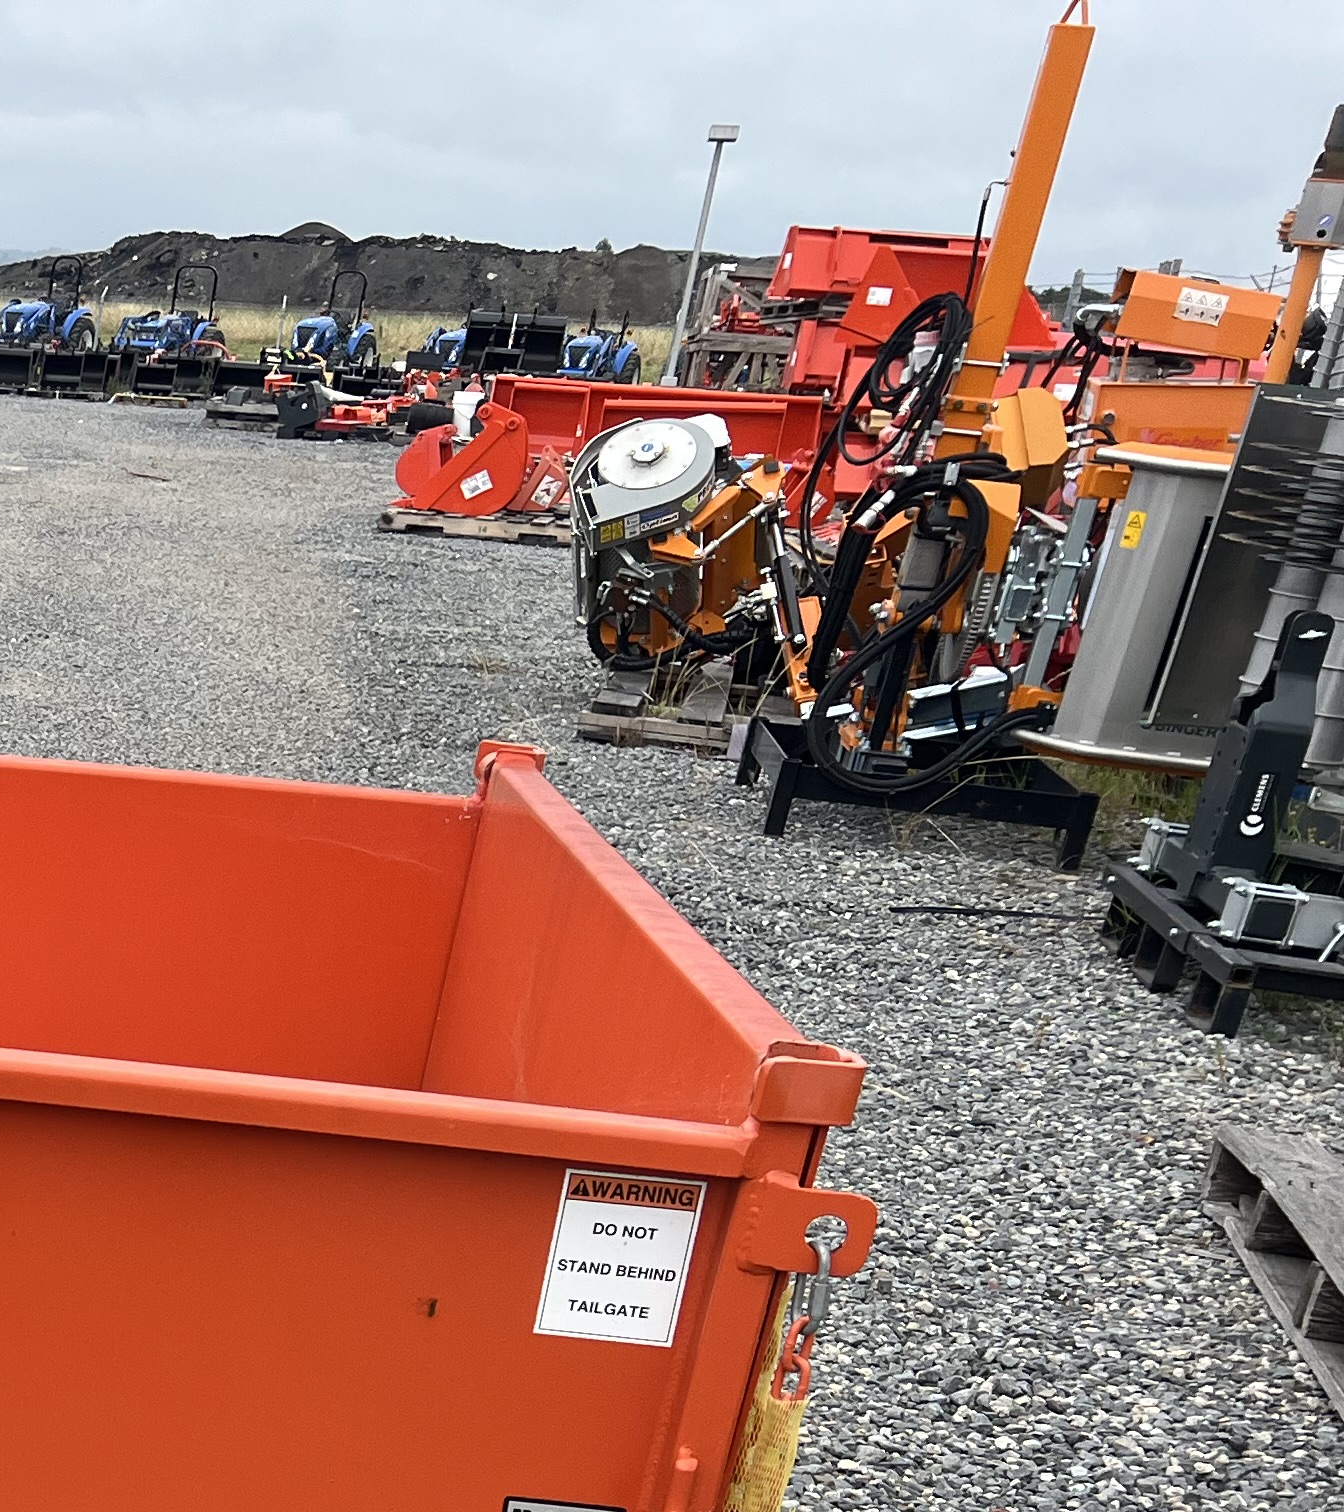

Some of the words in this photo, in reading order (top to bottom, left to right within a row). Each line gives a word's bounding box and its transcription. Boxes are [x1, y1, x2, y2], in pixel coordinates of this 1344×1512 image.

[1251, 773, 1270, 812] CLEMENS
[592, 1180, 695, 1207] WARNING
[592, 1222, 617, 1236] DO
[622, 1225, 659, 1240] NOT
[557, 1258, 612, 1276] STAND
[615, 1265, 676, 1282] BEHIND
[568, 1299, 650, 1319] TAILGATE
